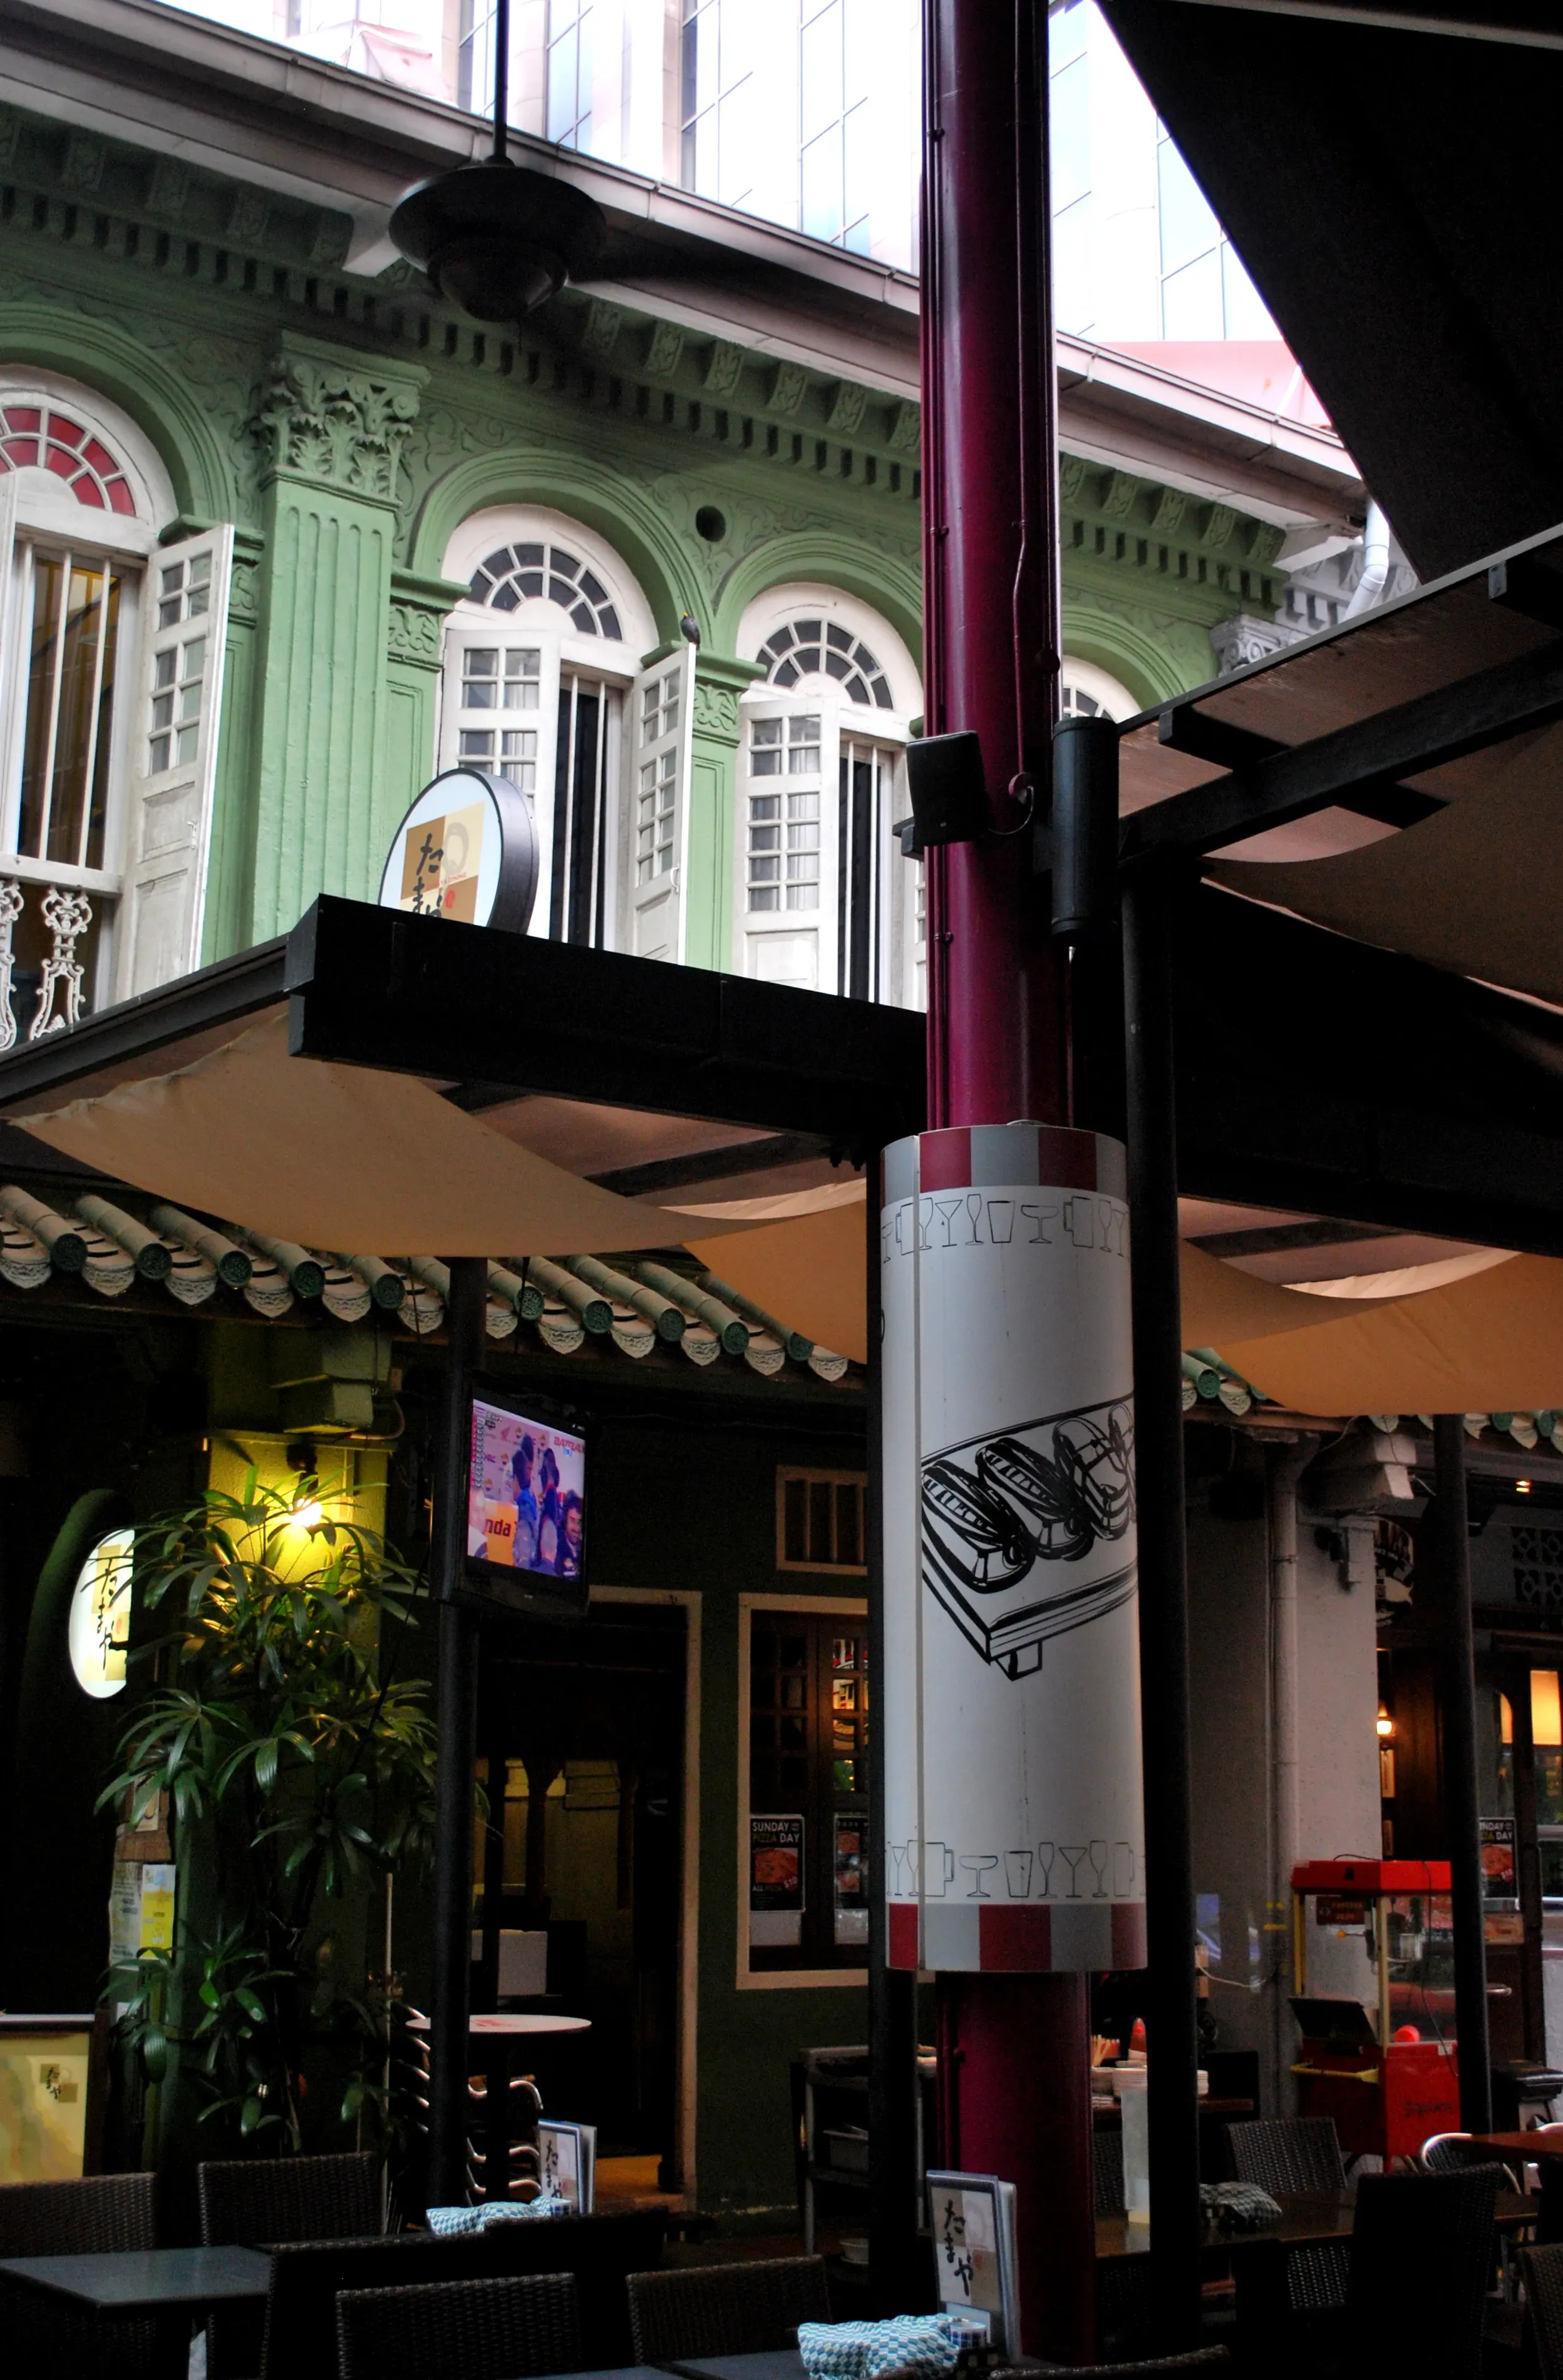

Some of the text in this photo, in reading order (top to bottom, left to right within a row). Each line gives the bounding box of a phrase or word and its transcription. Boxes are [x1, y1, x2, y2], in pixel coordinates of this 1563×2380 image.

[752, 1821, 789, 1832] SUNDAY
[779, 1833, 800, 1843] DAY
[1495, 1831, 1512, 1840] DAY
[944, 2199, 974, 2297] たまや
